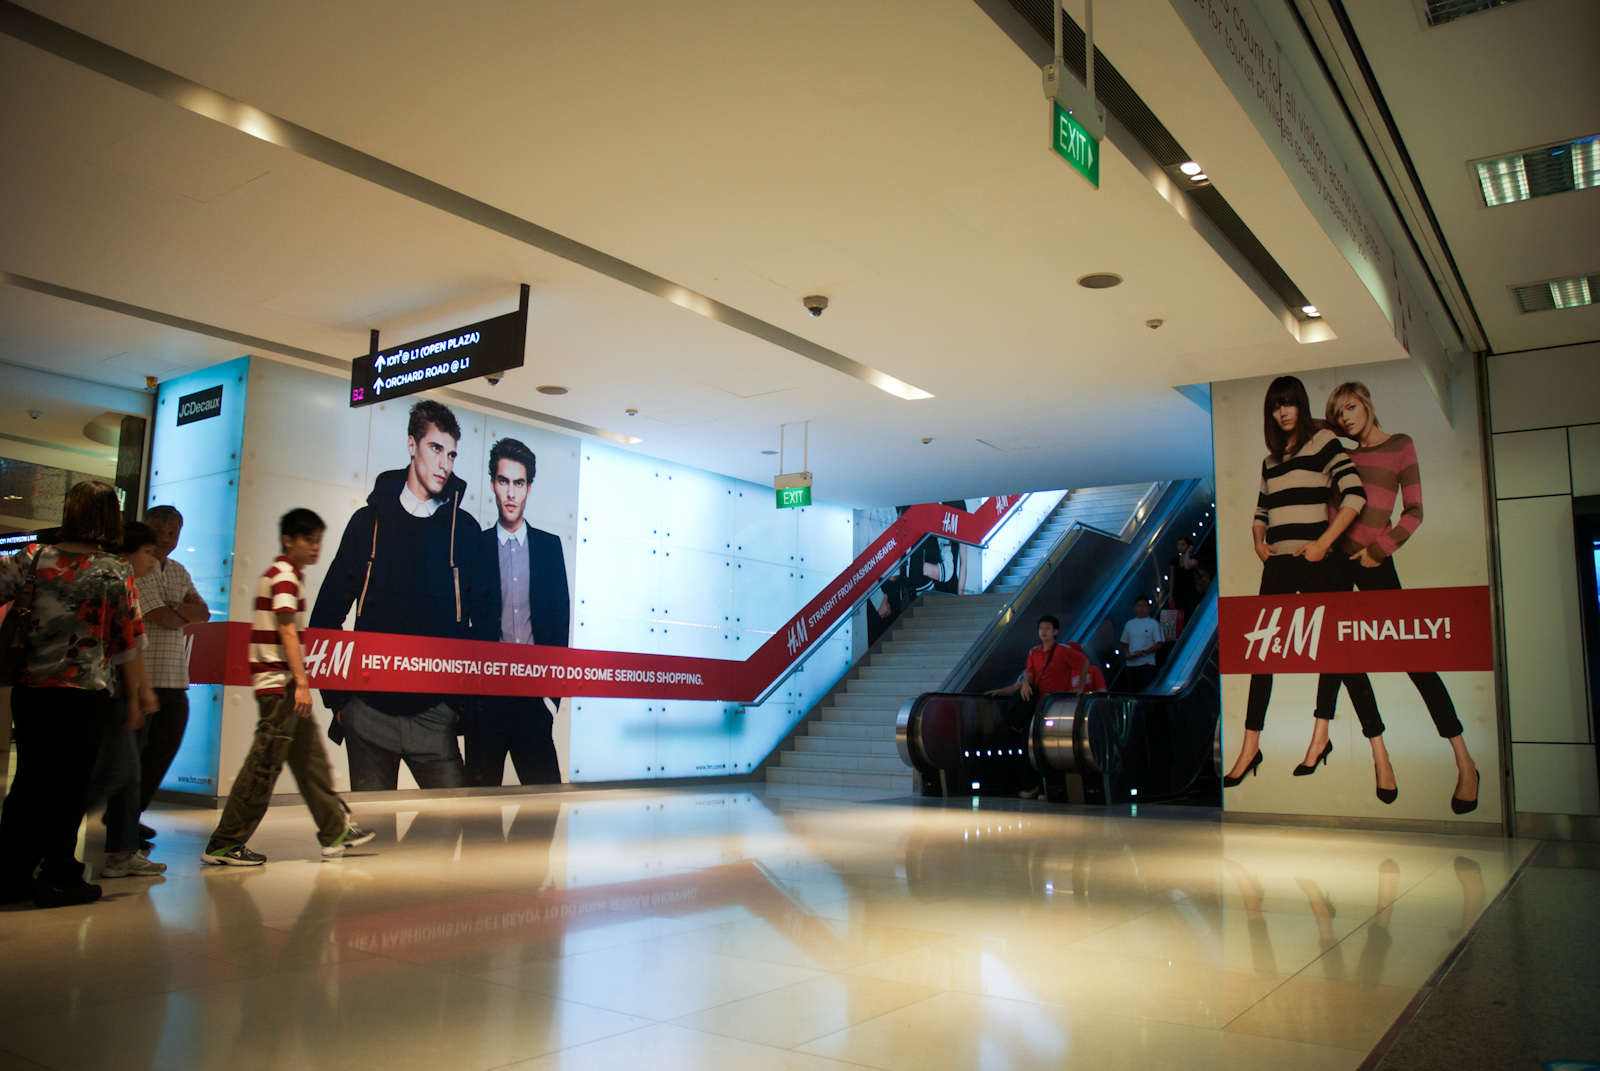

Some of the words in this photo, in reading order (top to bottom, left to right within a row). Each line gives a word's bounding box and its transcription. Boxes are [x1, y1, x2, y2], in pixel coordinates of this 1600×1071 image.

[1225, 25, 1254, 88] tourist
[1233, 7, 1266, 74] count
[1267, 58, 1283, 100] for
[1286, 92, 1296, 122] all
[1299, 112, 1328, 174] visitors
[1060, 115, 1086, 165] EXIT
[401, 352, 410, 364] @
[420, 341, 446, 359] (OPEN
[447, 331, 480, 350] PLAZA)
[352, 387, 365, 402] B2
[385, 369, 424, 389] ORCHARD
[425, 363, 449, 379] ROAD
[450, 360, 459, 373] @
[178, 397, 220, 418] JCDecaux
[783, 490, 803, 504] EXIT
[942, 511, 959, 535] H&M
[787, 616, 808, 656] H&M
[808, 595, 838, 628] STRAIGHT
[838, 582, 854, 600] FROM
[852, 560, 877, 585] FASHION
[1244, 605, 1325, 661] H&M
[1337, 617, 1451, 641] FINALLY!
[303, 639, 355, 680] H&M
[361, 654, 391, 670] HEY
[394, 656, 481, 674] FASHIONISTA!
[483, 662, 509, 676] GET
[510, 664, 548, 678] READY
[550, 665, 565, 679] TO
[566, 667, 583, 680] DO
[584, 667, 613, 681] SOME
[615, 669, 655, 683] SERIOUS
[656, 671, 704, 686] SHOPPING.
